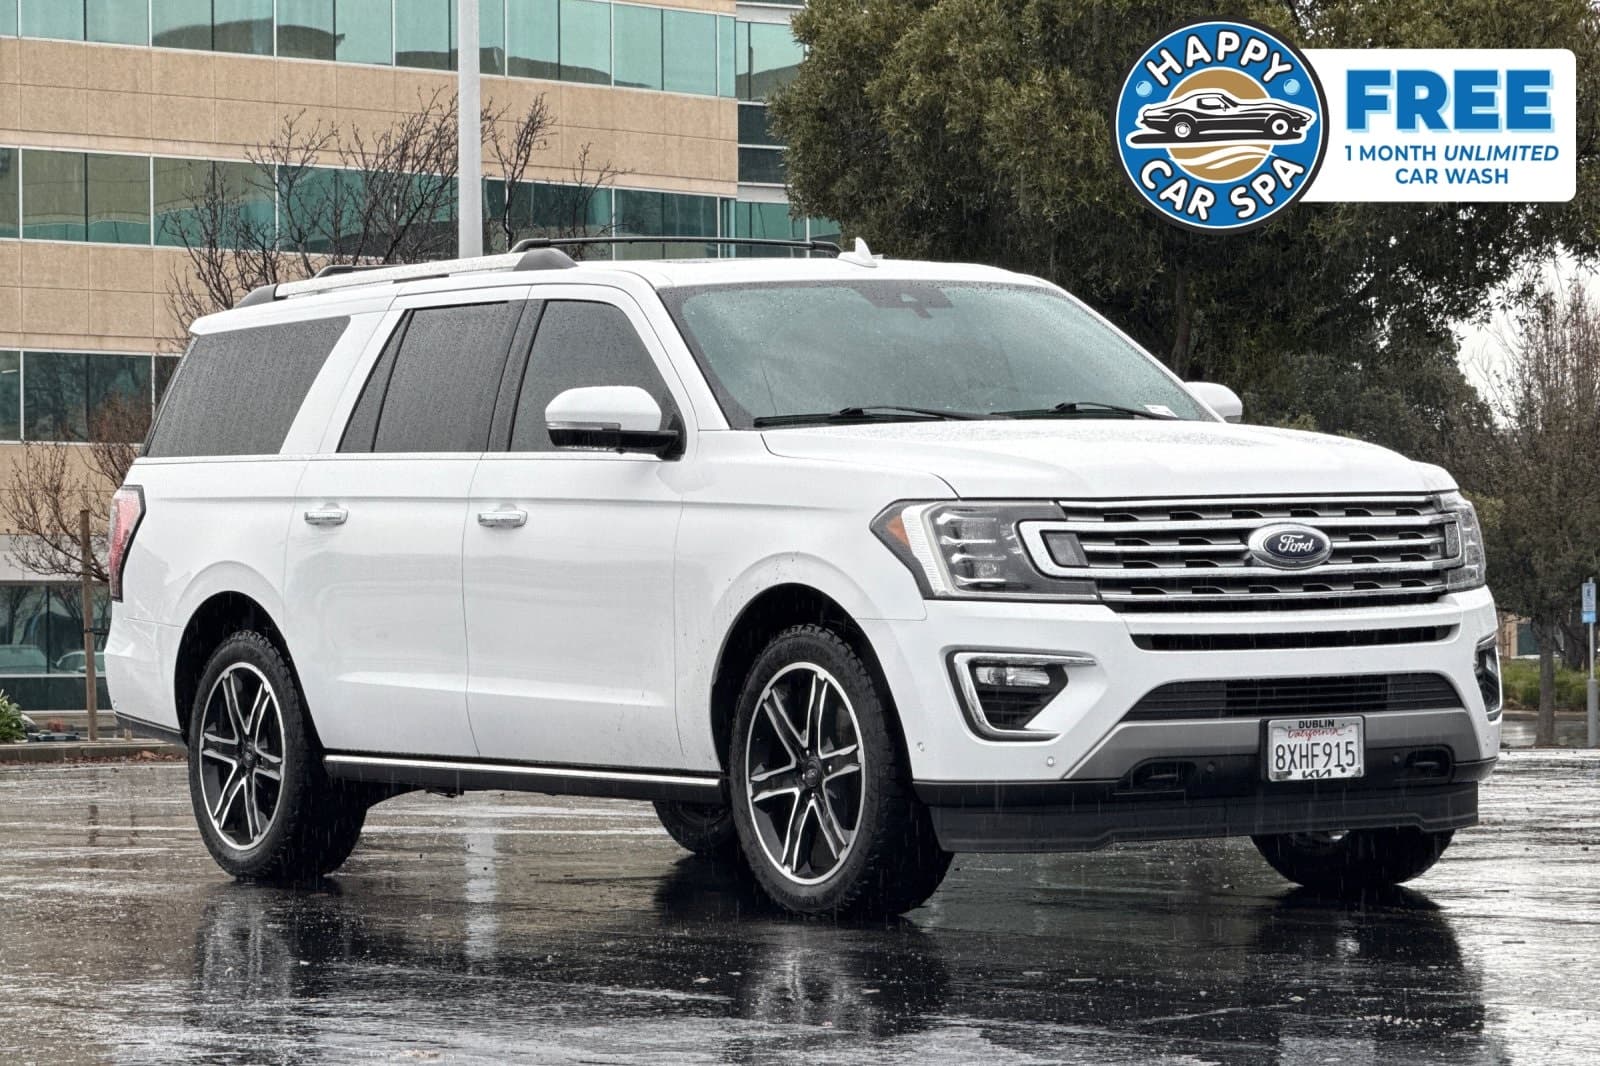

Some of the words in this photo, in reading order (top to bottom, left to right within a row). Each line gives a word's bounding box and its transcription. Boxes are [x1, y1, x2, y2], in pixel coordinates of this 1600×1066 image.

[1278, 533, 1314, 552] Ford
[1299, 719, 1335, 729] DUBLIN
[1288, 728, 1344, 740] California
[1275, 741, 1355, 770] 8XHF915
